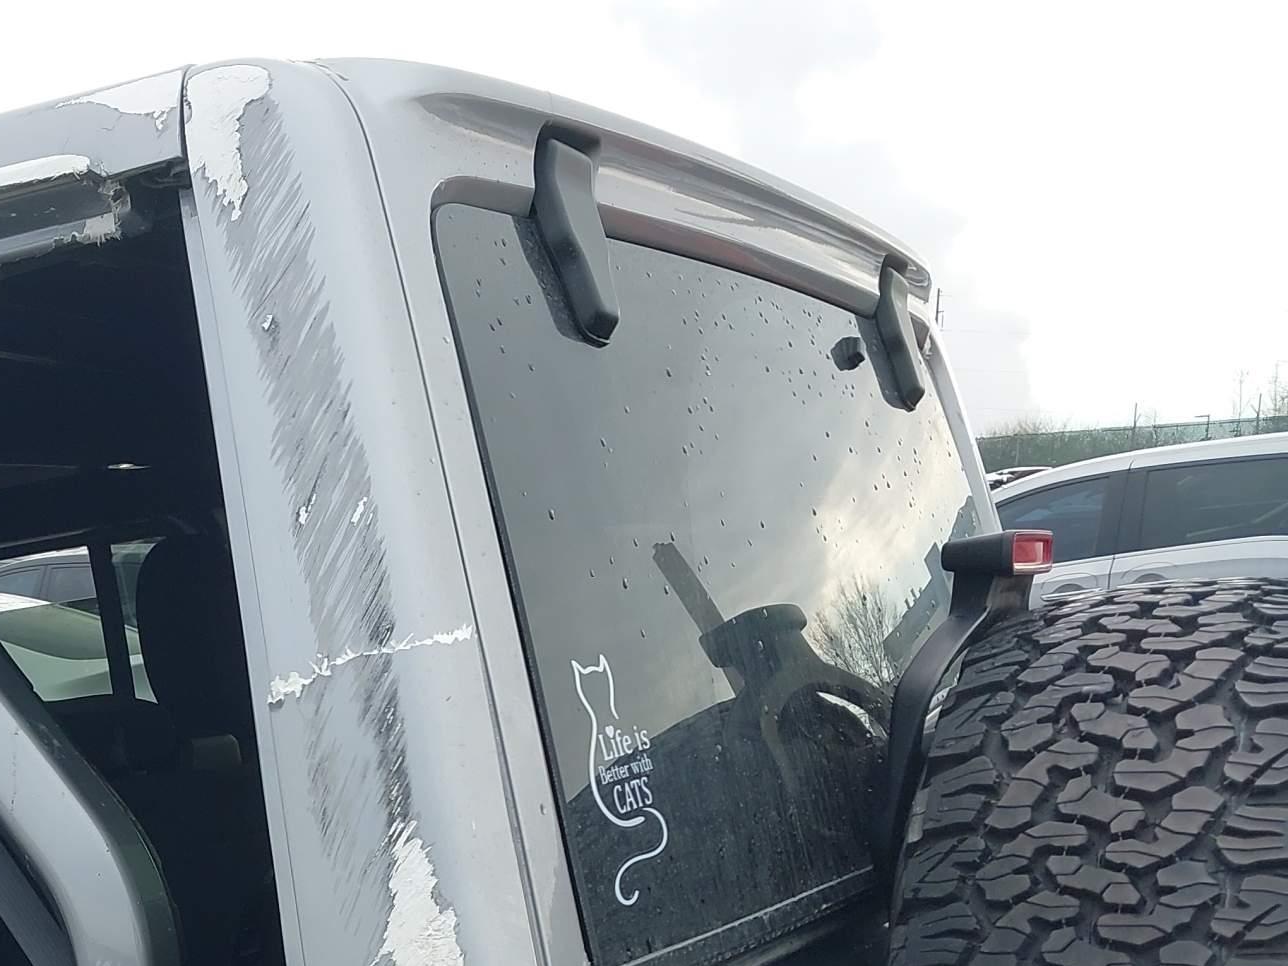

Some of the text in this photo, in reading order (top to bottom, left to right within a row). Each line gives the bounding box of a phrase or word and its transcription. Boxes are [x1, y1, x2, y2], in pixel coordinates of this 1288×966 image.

[598, 726, 651, 761] Life is
[598, 753, 654, 785] Better with
[613, 776, 654, 815] CATS
